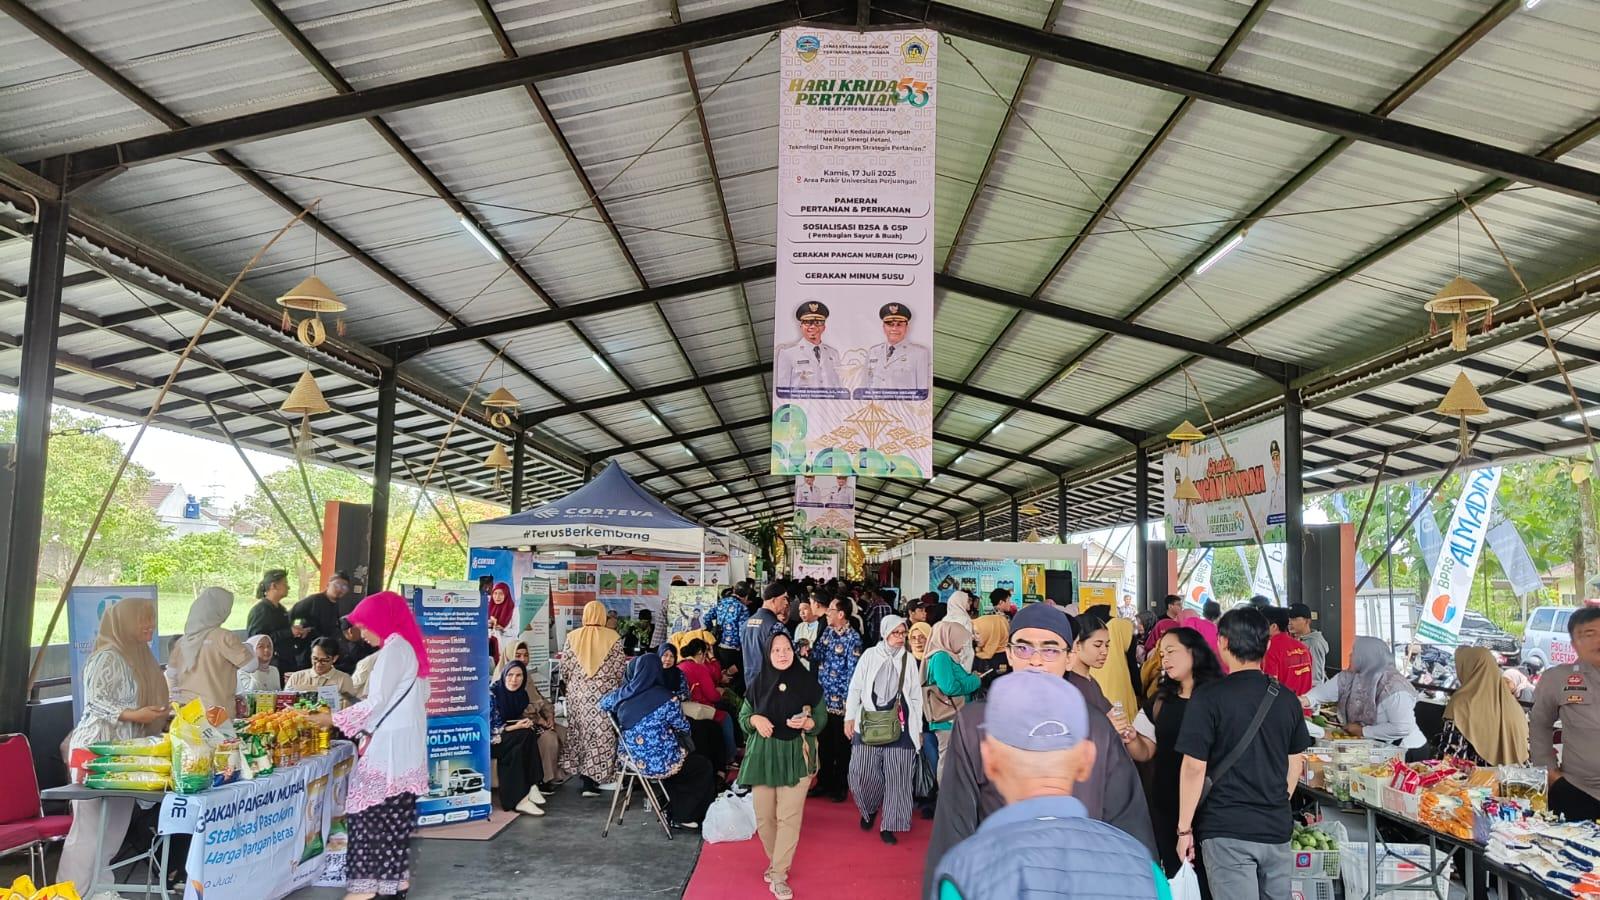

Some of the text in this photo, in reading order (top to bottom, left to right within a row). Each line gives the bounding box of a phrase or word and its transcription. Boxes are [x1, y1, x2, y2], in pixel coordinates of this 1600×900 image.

[789, 79, 835, 92] HARI
[838, 79, 899, 92] KRIDA
[795, 92, 898, 106] PERTANIAN
[823, 169, 850, 177] Kamis,
[879, 178, 917, 186] Perjuangan
[800, 205, 850, 213] PERTANIAN
[860, 206, 911, 214] PERIKANAN
[802, 223, 856, 231] SOSIALISASI
[812, 232, 852, 240] Pembagian
[865, 252, 894, 260] MURAH
[805, 272, 905, 281] GERAKAN MINUM SUSU
[565, 507, 654, 517] CORTEVA
[523, 525, 650, 542] #TerusBerkembang
[1436, 556, 1456, 590] BPRS
[458, 731, 481, 743] WIN
[205, 847, 241, 865] Harga
[272, 826, 294, 845] Beras
